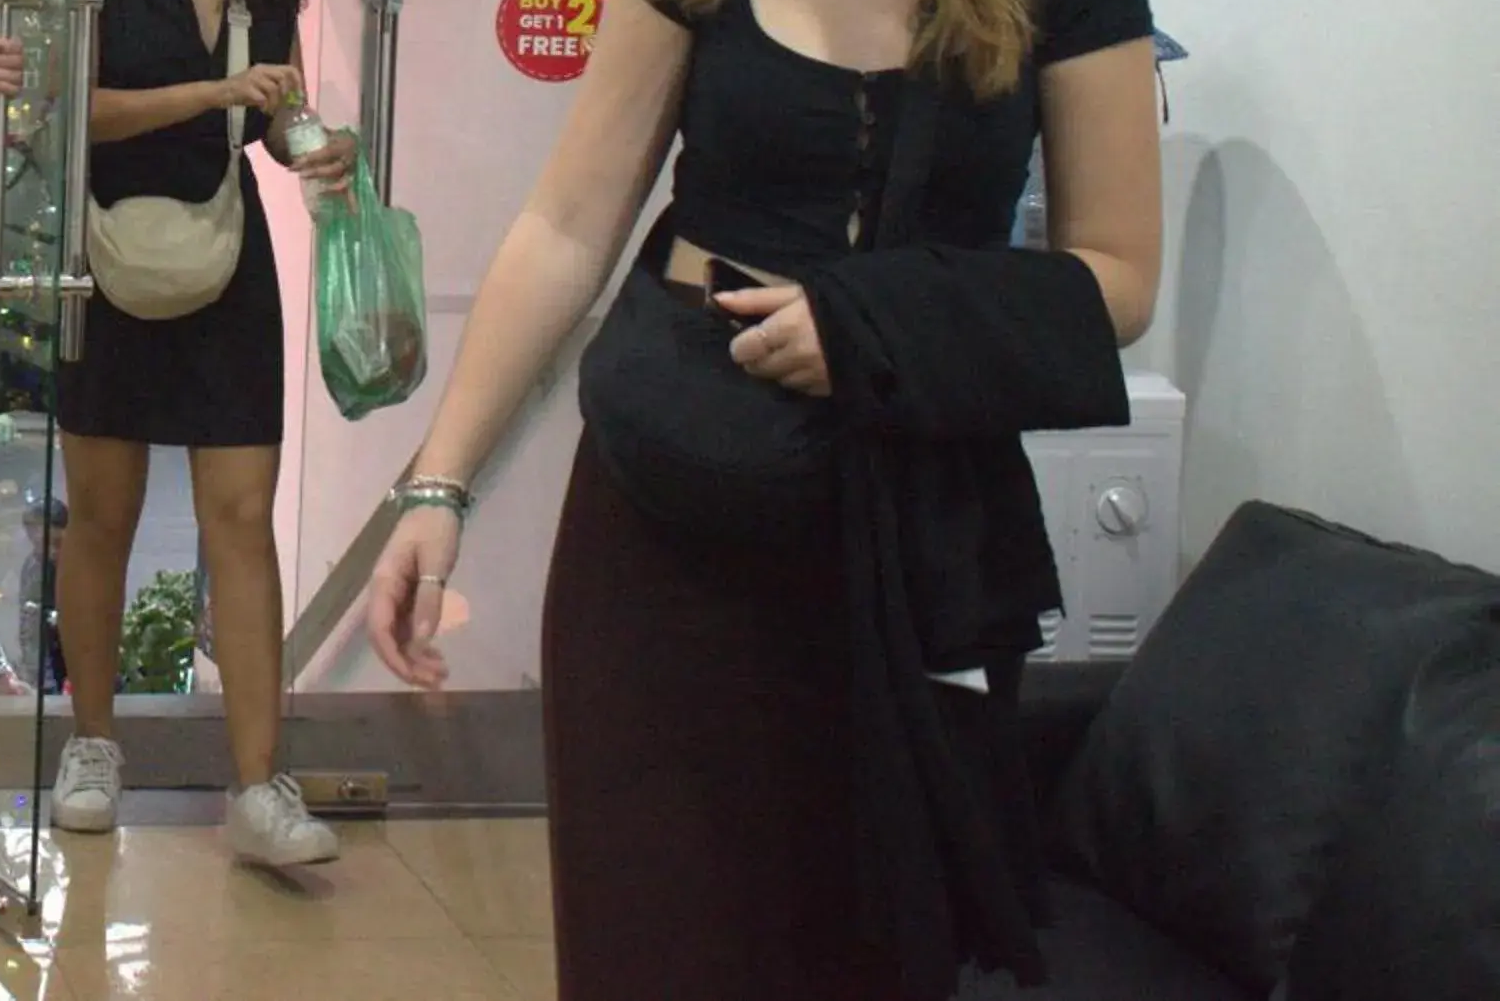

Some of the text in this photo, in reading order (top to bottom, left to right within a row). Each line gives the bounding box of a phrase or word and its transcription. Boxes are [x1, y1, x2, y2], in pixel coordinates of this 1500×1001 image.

[519, 14, 564, 30] GET 1
[517, 34, 579, 57] FREE
